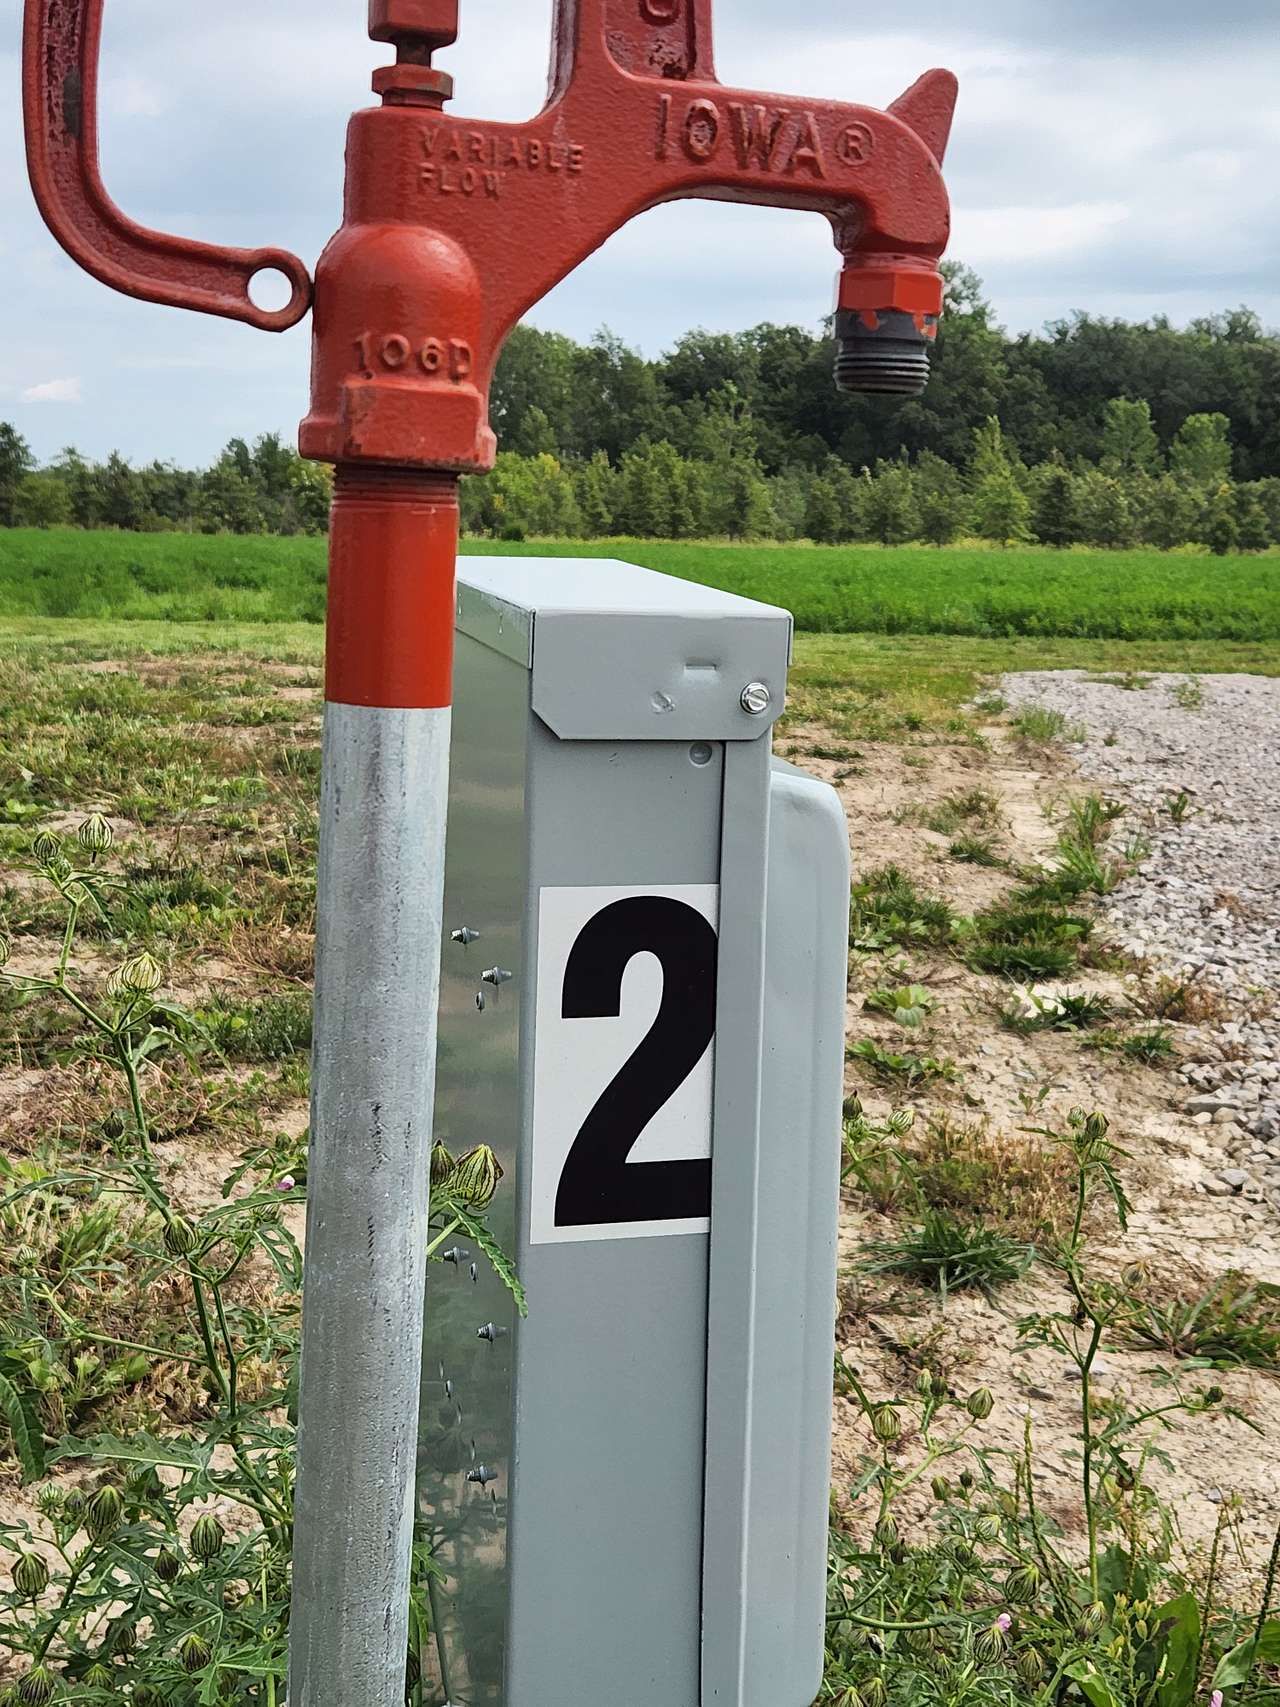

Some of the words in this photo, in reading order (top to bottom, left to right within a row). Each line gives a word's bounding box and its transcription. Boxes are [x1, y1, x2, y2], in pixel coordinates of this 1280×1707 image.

[418, 126, 584, 173] VARIABLE
[418, 161, 506, 199] FLOW
[554, 895, 718, 1227] 2
